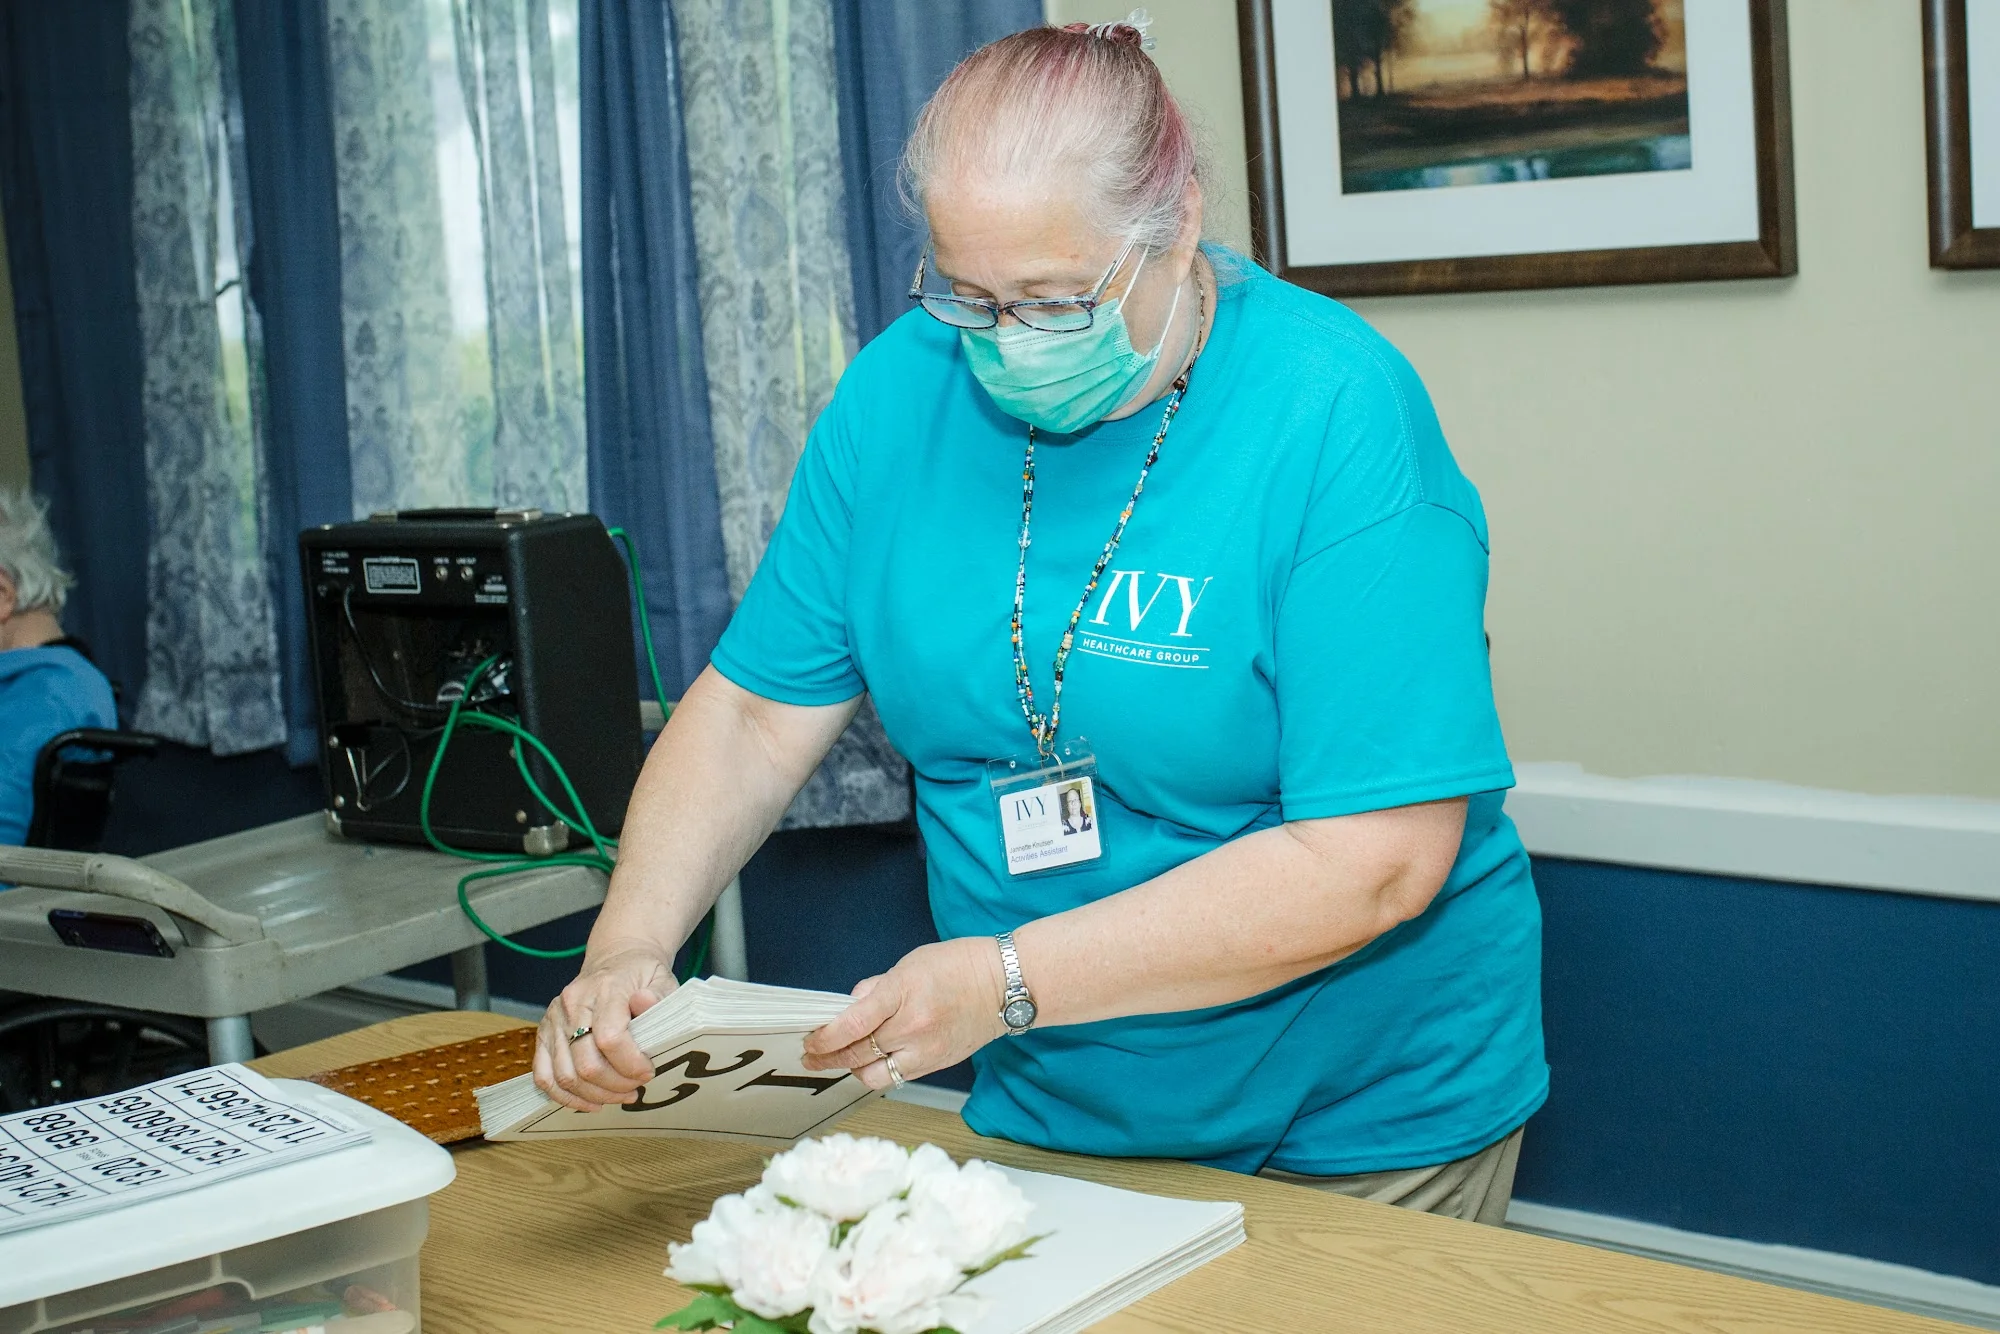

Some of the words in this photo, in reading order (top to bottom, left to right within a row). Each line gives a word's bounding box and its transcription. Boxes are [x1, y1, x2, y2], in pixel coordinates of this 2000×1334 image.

[1088, 569, 1214, 637] IVY
[1082, 638, 1152, 660] HEALTHCARE
[1156, 651, 1200, 663] GROUP
[1014, 793, 1048, 821] IVY
[1010, 852, 1039, 864] Activities
[1039, 845, 1068, 857] Assistant
[172, 1076, 225, 1096] 71
[98, 1095, 152, 1115] 65
[196, 1090, 250, 1112] 56
[122, 1109, 176, 1129] 60
[222, 1103, 271, 1120] 42
[23, 1113, 77, 1133] 68
[247, 1113, 304, 1133] 23
[45, 1129, 100, 1150] 59
[146, 1124, 201, 1143] 38
[274, 1126, 326, 1144] 11
[168, 1136, 228, 1155] 27
[194, 1147, 250, 1165] 15
[91, 1157, 149, 1176] 20
[115, 1168, 171, 1187] 13
[8, 1178, 68, 1198] 21
[30, 1189, 88, 1207] 14
